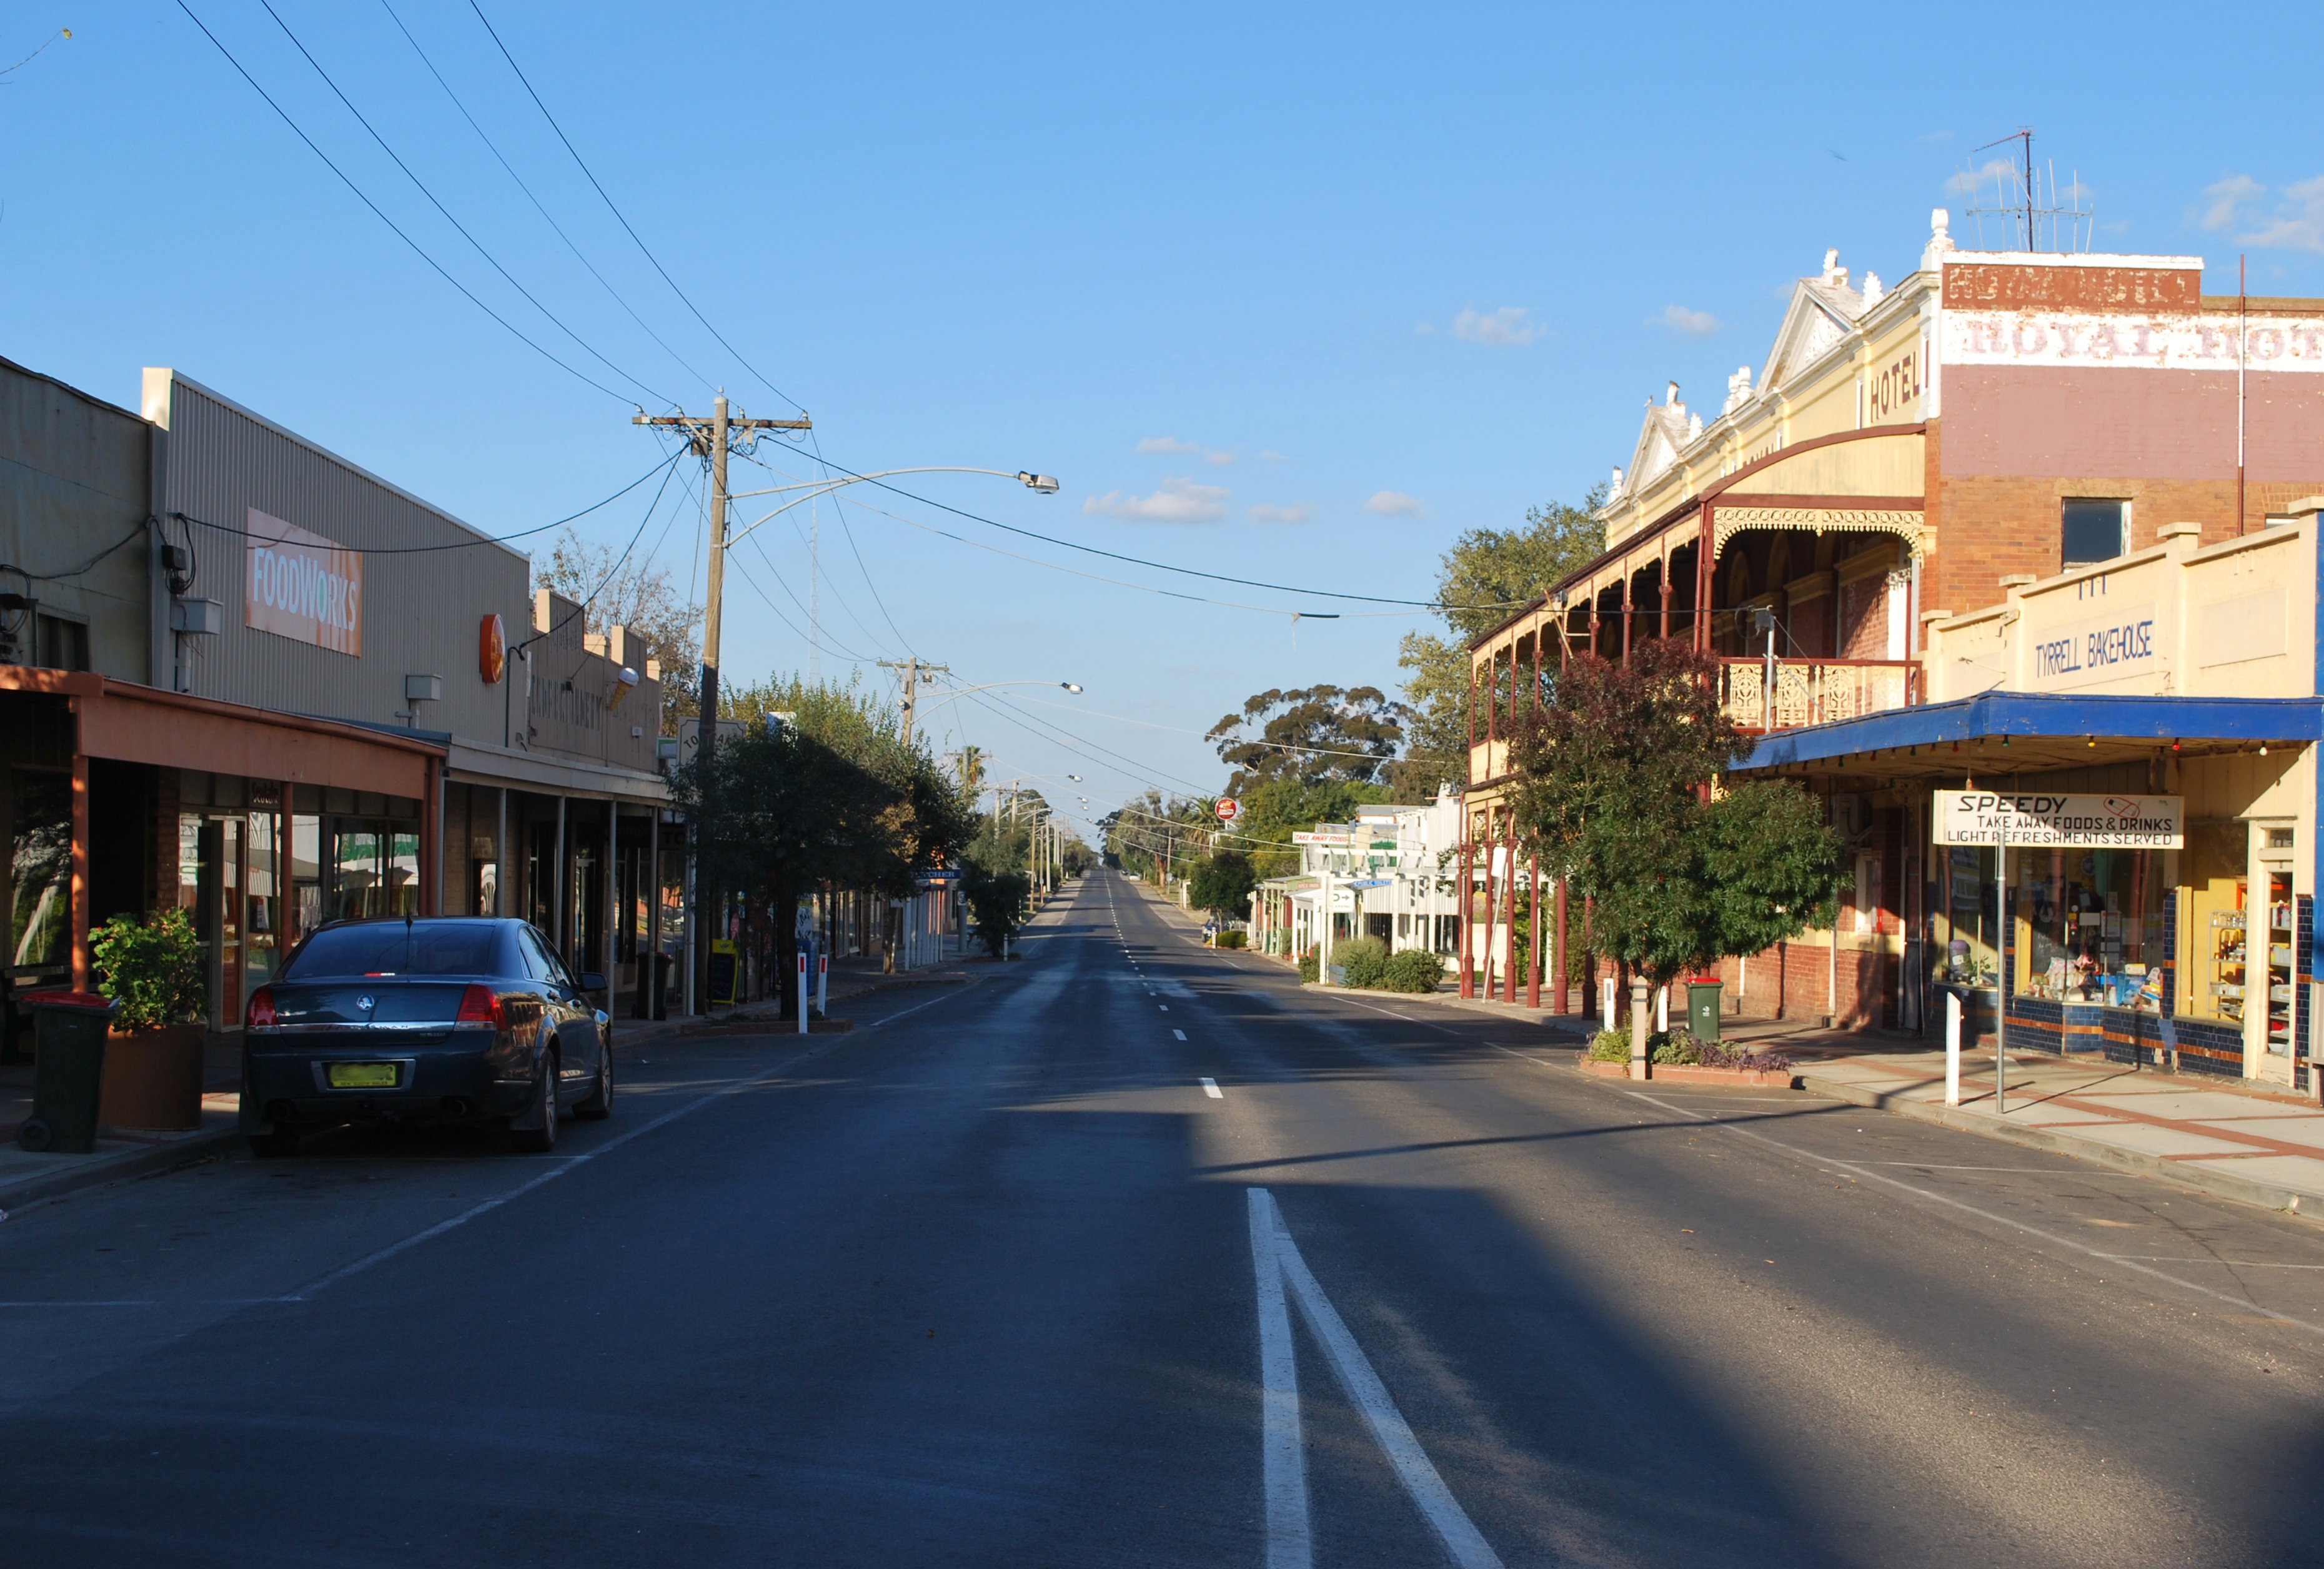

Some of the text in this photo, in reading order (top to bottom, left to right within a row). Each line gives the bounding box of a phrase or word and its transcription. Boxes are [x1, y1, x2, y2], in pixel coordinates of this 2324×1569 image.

[1967, 320, 2168, 359] ROYAL
[1870, 351, 1920, 423] HOTEL
[254, 545, 357, 631] FOODWORKS
[2035, 620, 2153, 678] TYRRELL BAKEHOUSE
[1958, 796, 2067, 814] SPEEDY
[1977, 815, 2172, 831] TAKE AWAY FOODS & DRINKS
[1948, 831, 2172, 845] LIGHT REFRESHMENTS SERVED
